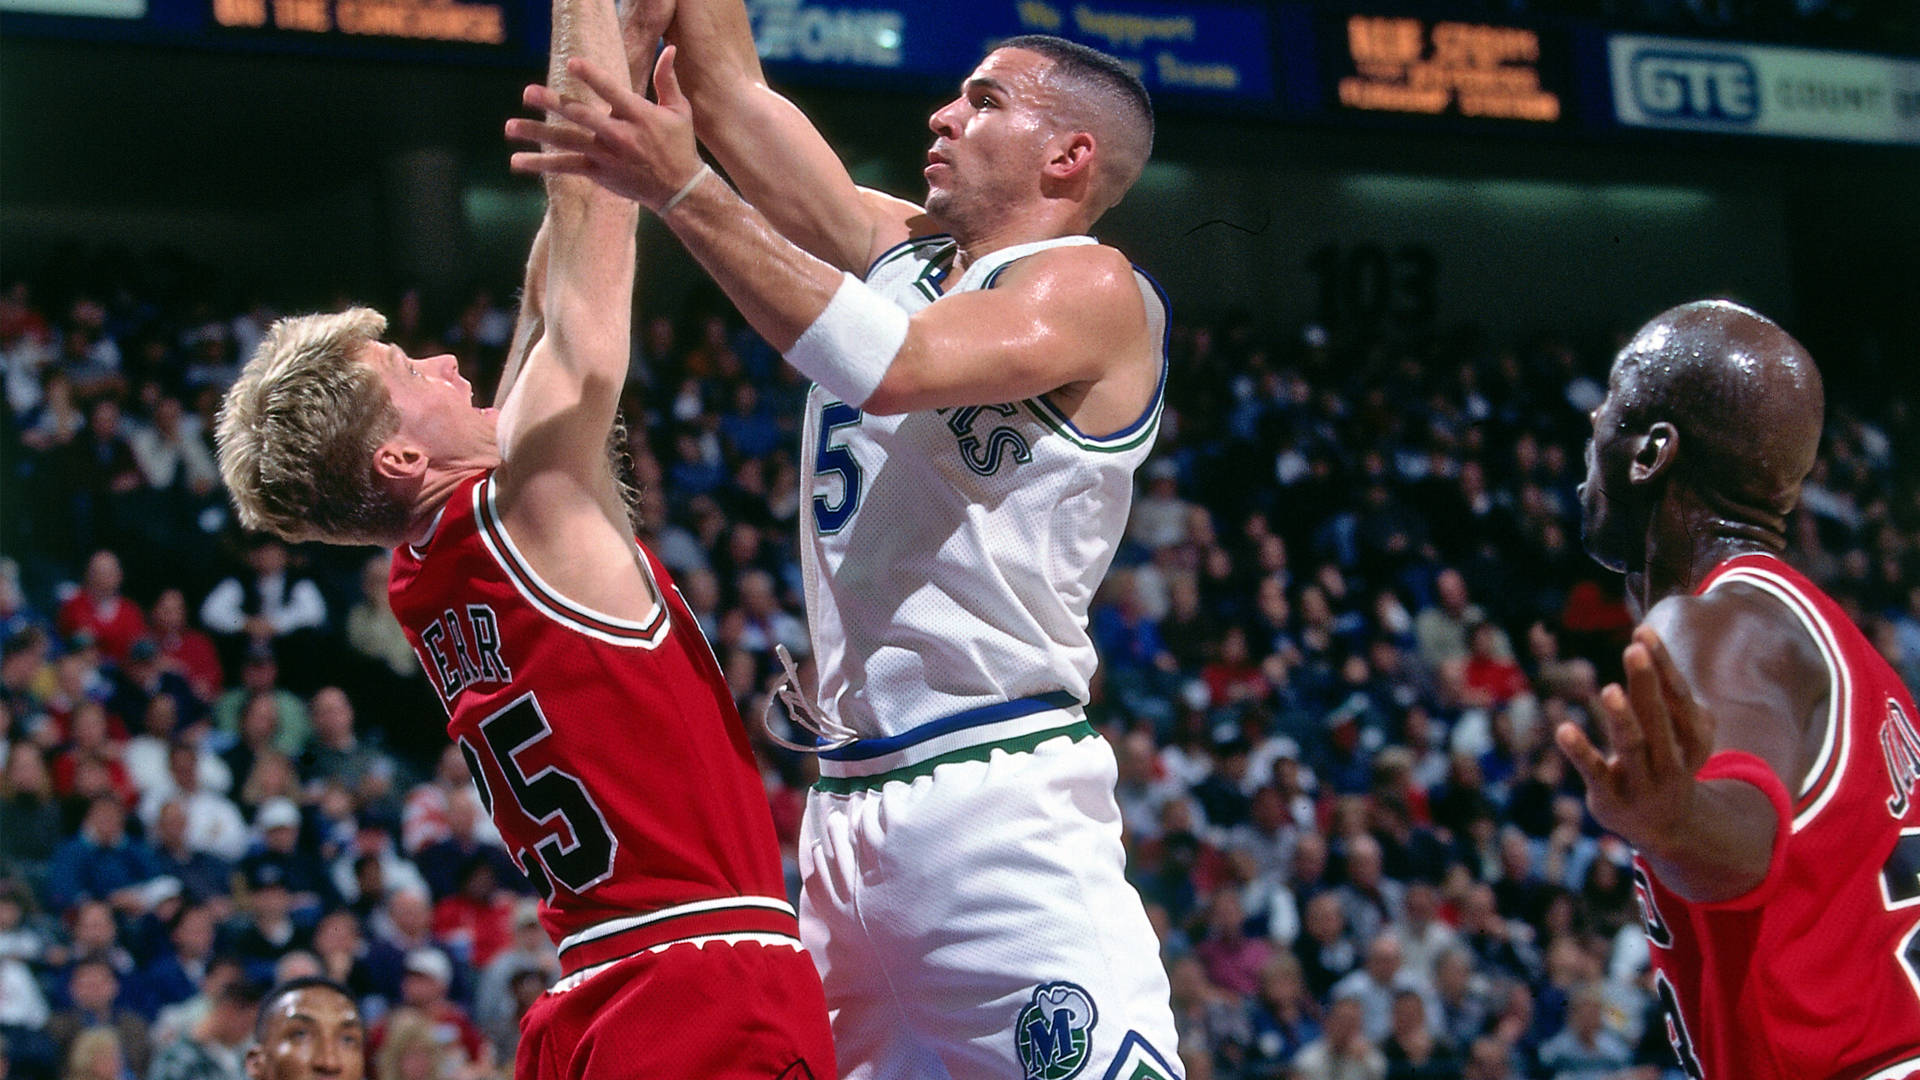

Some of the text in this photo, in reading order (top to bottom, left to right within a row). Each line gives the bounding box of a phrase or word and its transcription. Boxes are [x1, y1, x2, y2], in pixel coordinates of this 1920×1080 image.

[1635, 57, 1754, 119] GTE
[1304, 243, 1438, 323] 103
[415, 603, 513, 702] ERR
